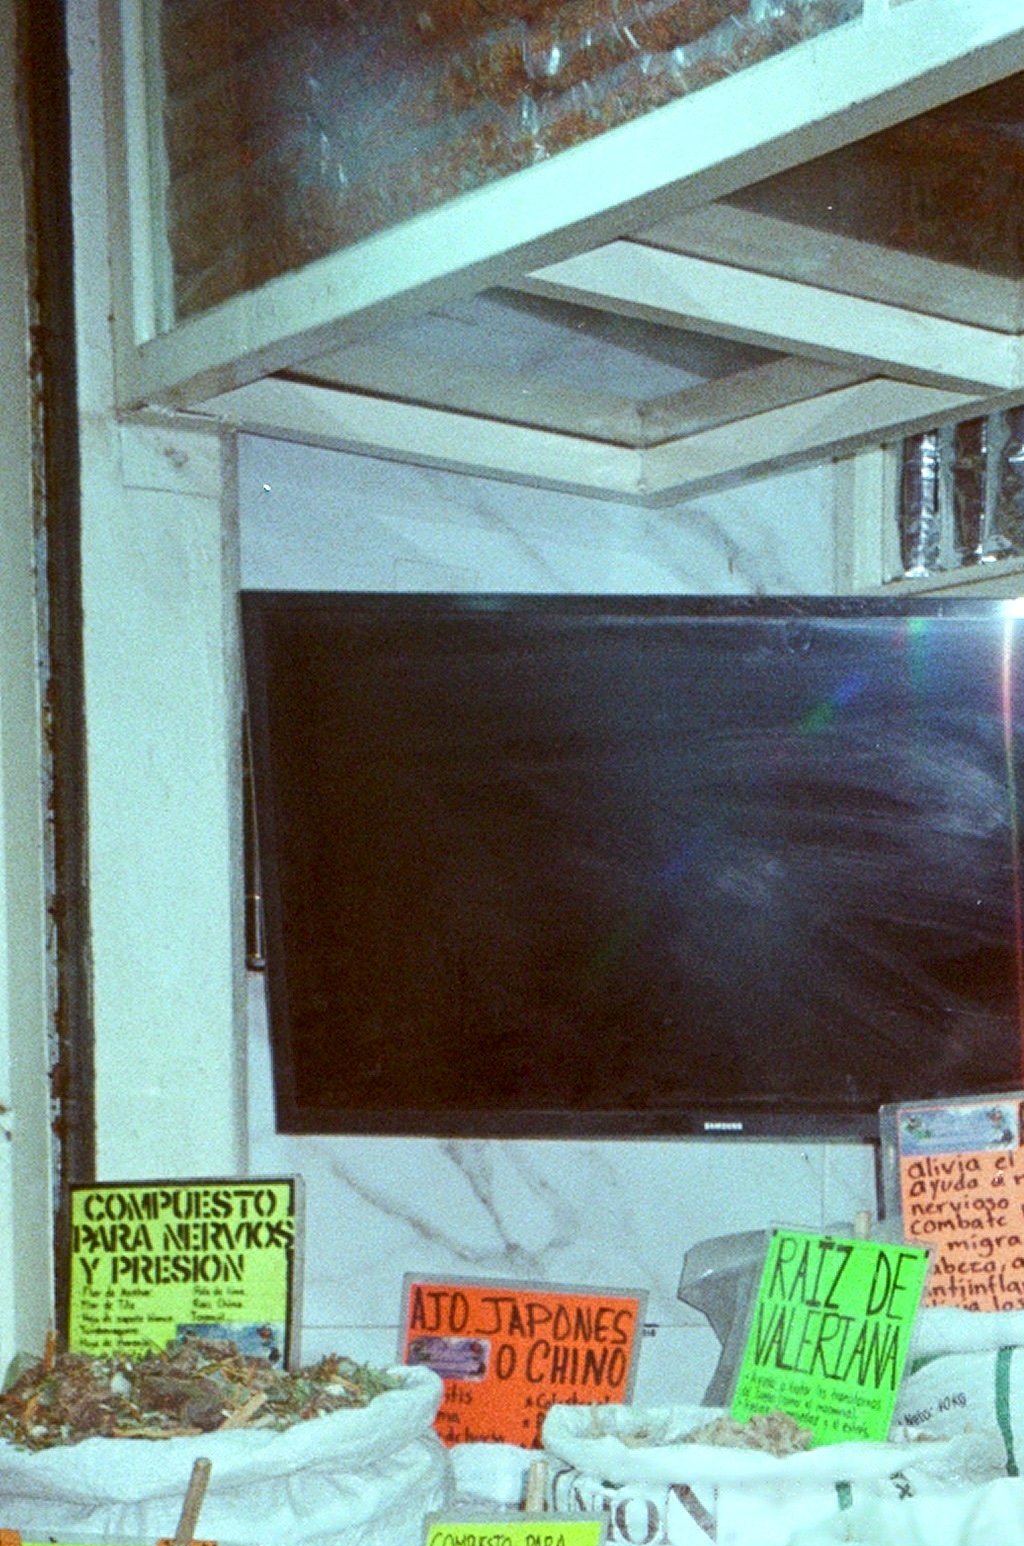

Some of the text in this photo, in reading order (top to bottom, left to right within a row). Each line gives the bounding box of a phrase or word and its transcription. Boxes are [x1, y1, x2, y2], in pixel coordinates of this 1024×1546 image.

[908, 1154, 980, 1179] alivia
[994, 1150, 1014, 1170] el
[84, 1189, 276, 1222] COMPUESTO
[910, 1196, 1009, 1217] nervioso
[73, 1220, 294, 1253] PARA NERVIOS
[910, 1214, 1007, 1236] combate
[80, 1254, 244, 1284] Y PRESION
[866, 1250, 917, 1320] DE
[475, 1297, 632, 1345] JAPONES
[754, 1302, 901, 1391] VALERIANA
[495, 1339, 629, 1388] O CHINO
